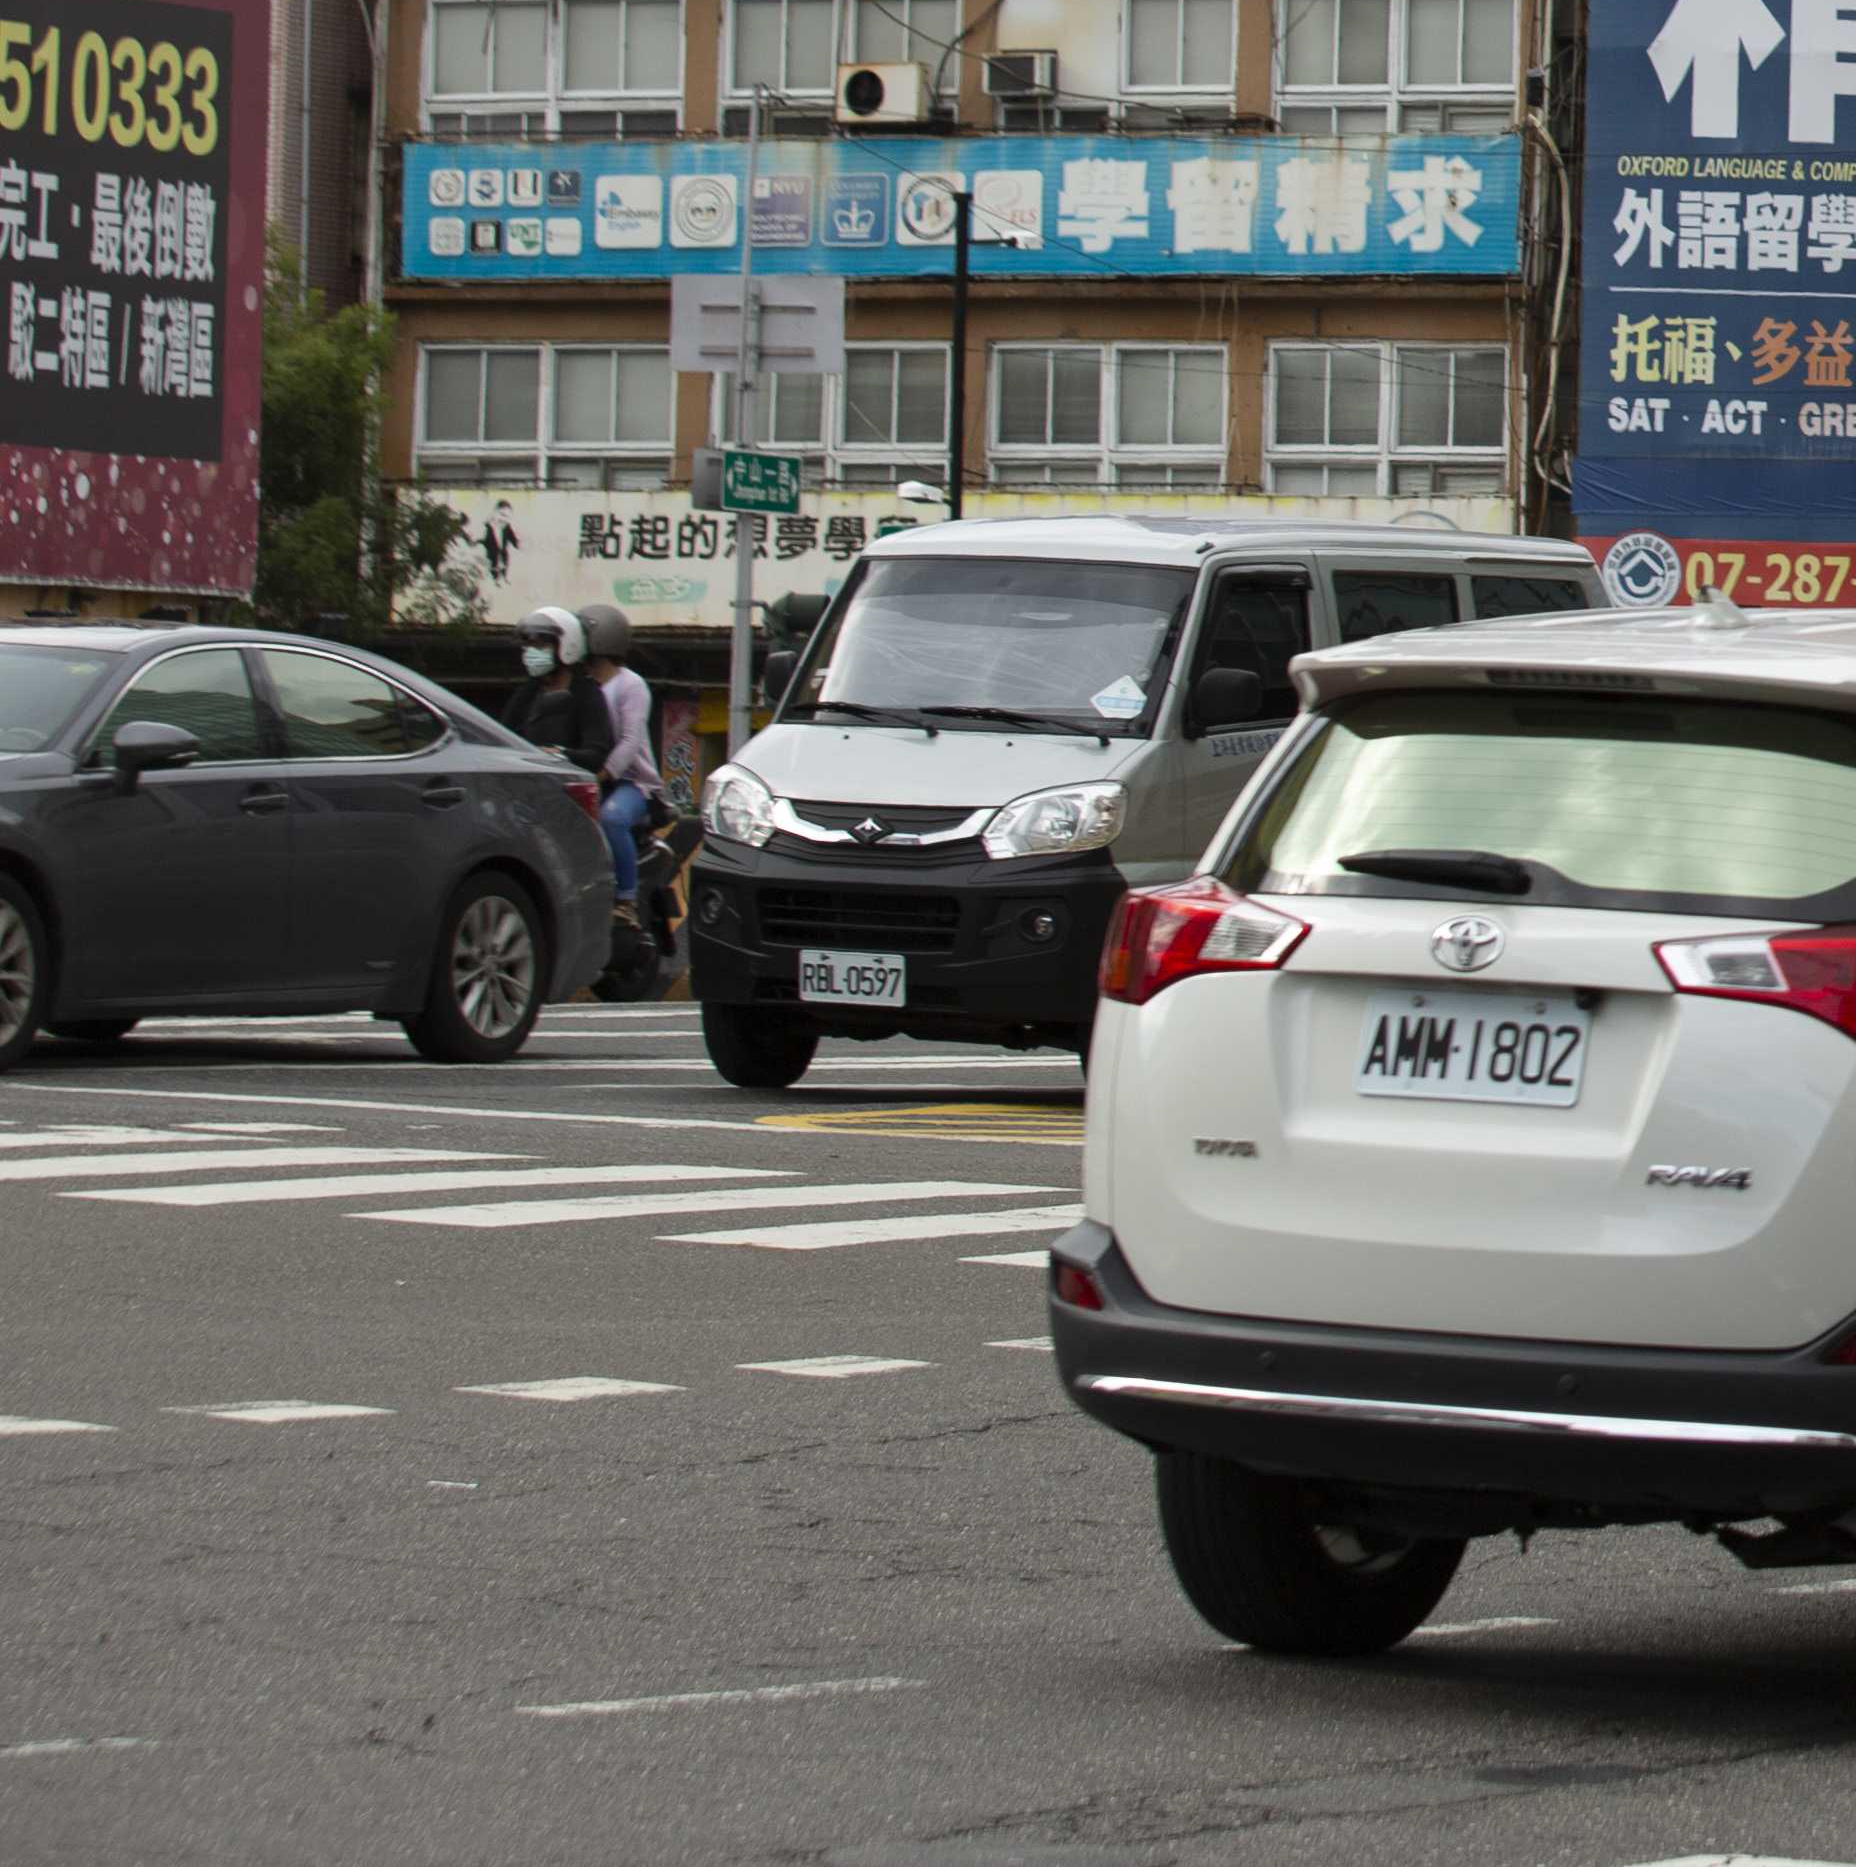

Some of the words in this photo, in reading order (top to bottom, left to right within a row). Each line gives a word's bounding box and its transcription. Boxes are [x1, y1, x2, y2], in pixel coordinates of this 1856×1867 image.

[0, 19, 219, 156] 510333
[1618, 155, 1688, 177] OXFORD
[1693, 159, 1787, 180] LANGUAGE
[1792, 162, 1804, 181] &
[1608, 397, 1670, 433] SAT
[1702, 399, 1767, 435] ACT
[1195, 1135, 1259, 1160] TOYOTA
[1646, 1163, 1753, 1192] RAV4
